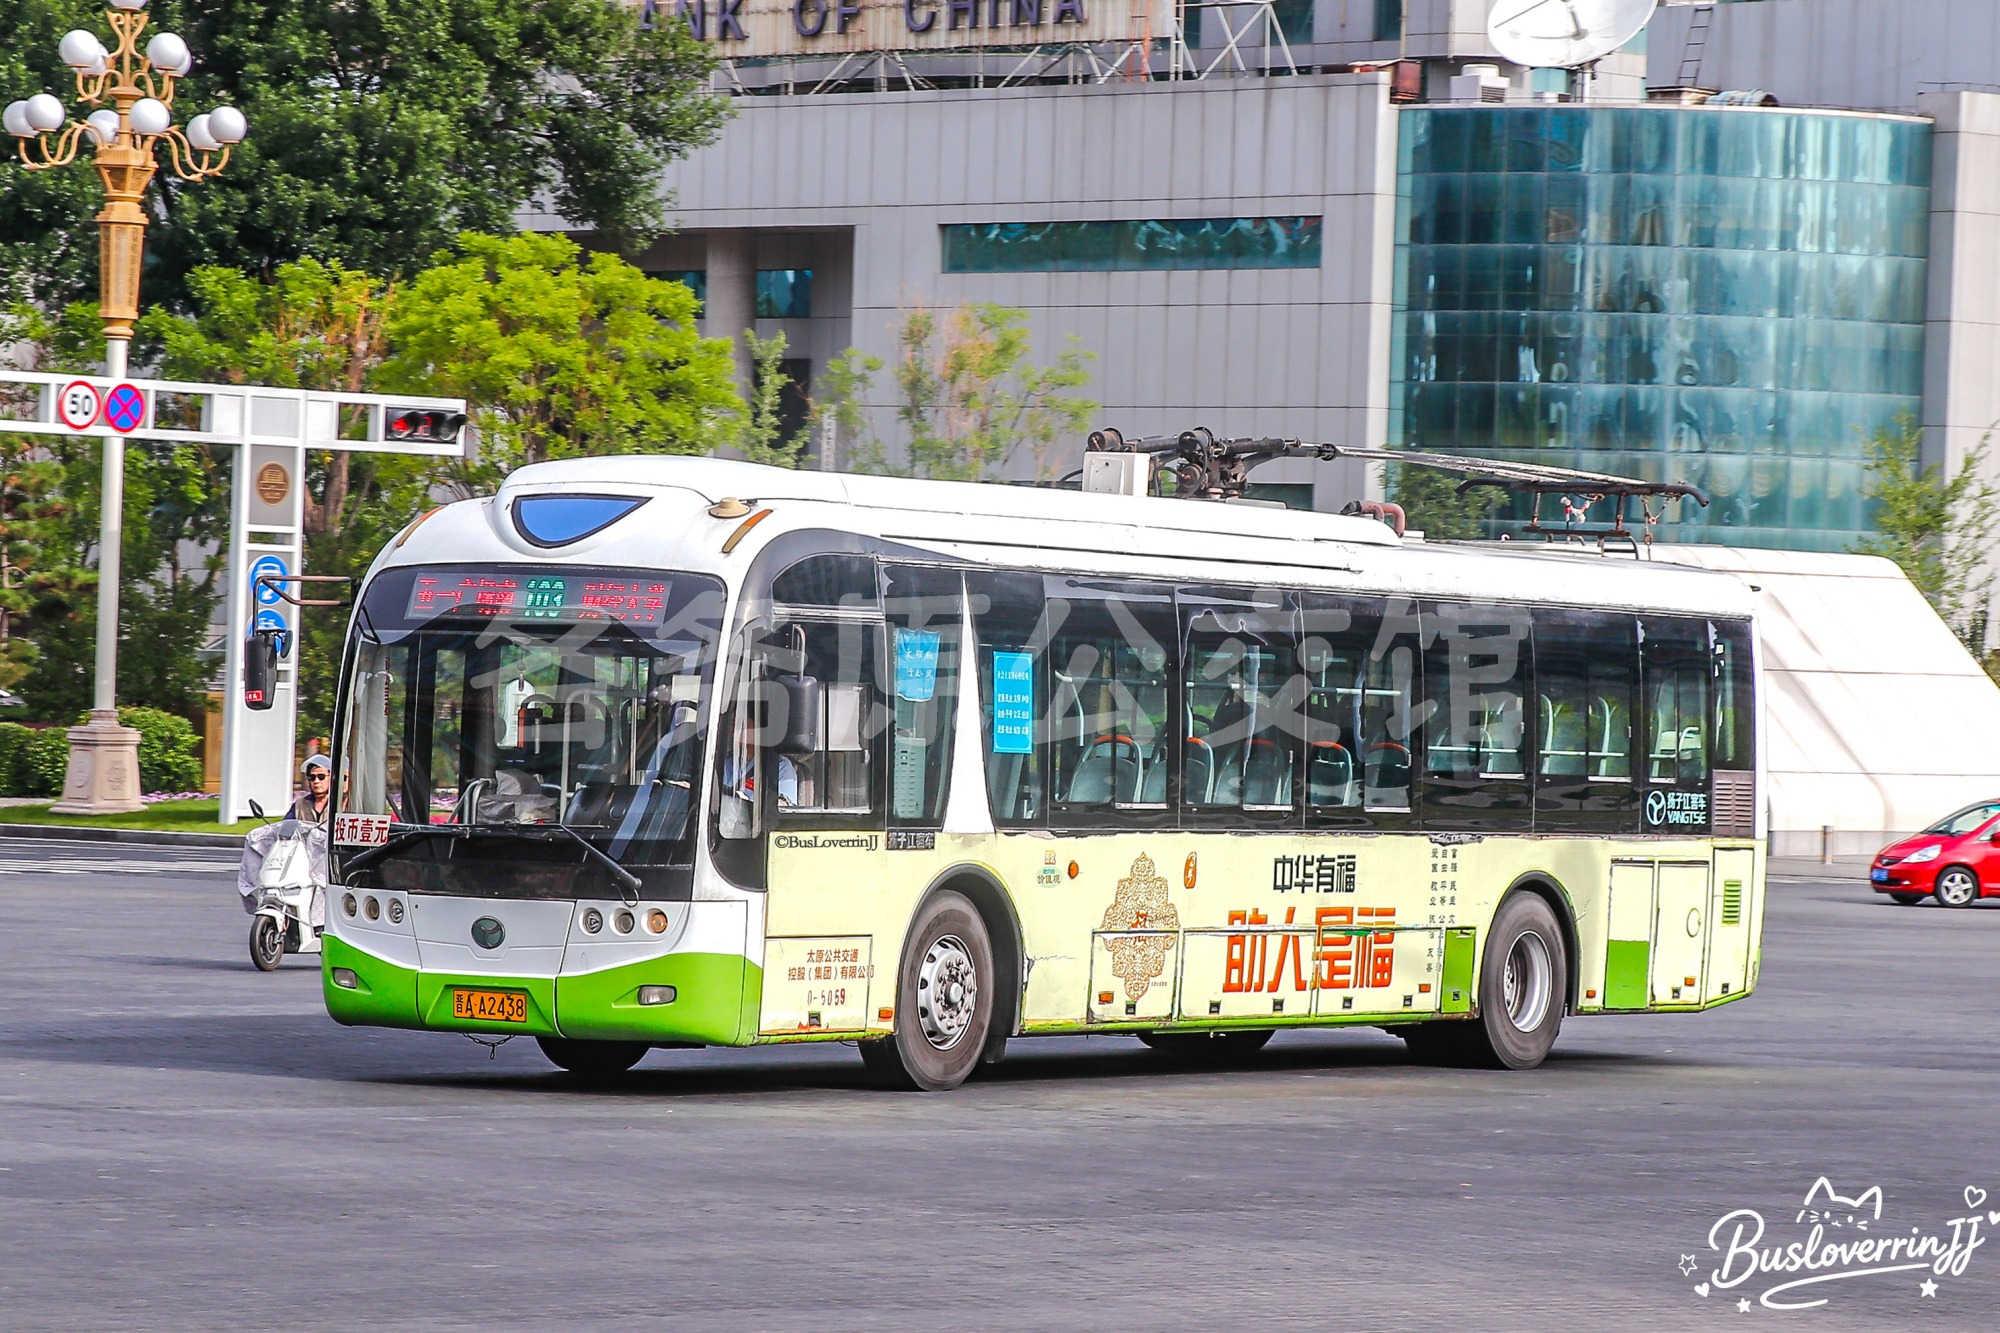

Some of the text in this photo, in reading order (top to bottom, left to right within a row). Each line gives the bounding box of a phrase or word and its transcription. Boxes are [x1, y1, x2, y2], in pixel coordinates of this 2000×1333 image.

[793, 0, 862, 36] OF
[904, 0, 1085, 32] CHINA
[68, 394, 92, 416] 50
[335, 817, 388, 844] 投币壹元
[1667, 810, 1707, 825] YANGTSE
[1273, 854, 1357, 894] 中华有福
[806, 948, 859, 963] 太原公共交通
[1222, 906, 1396, 993] 助人是福
